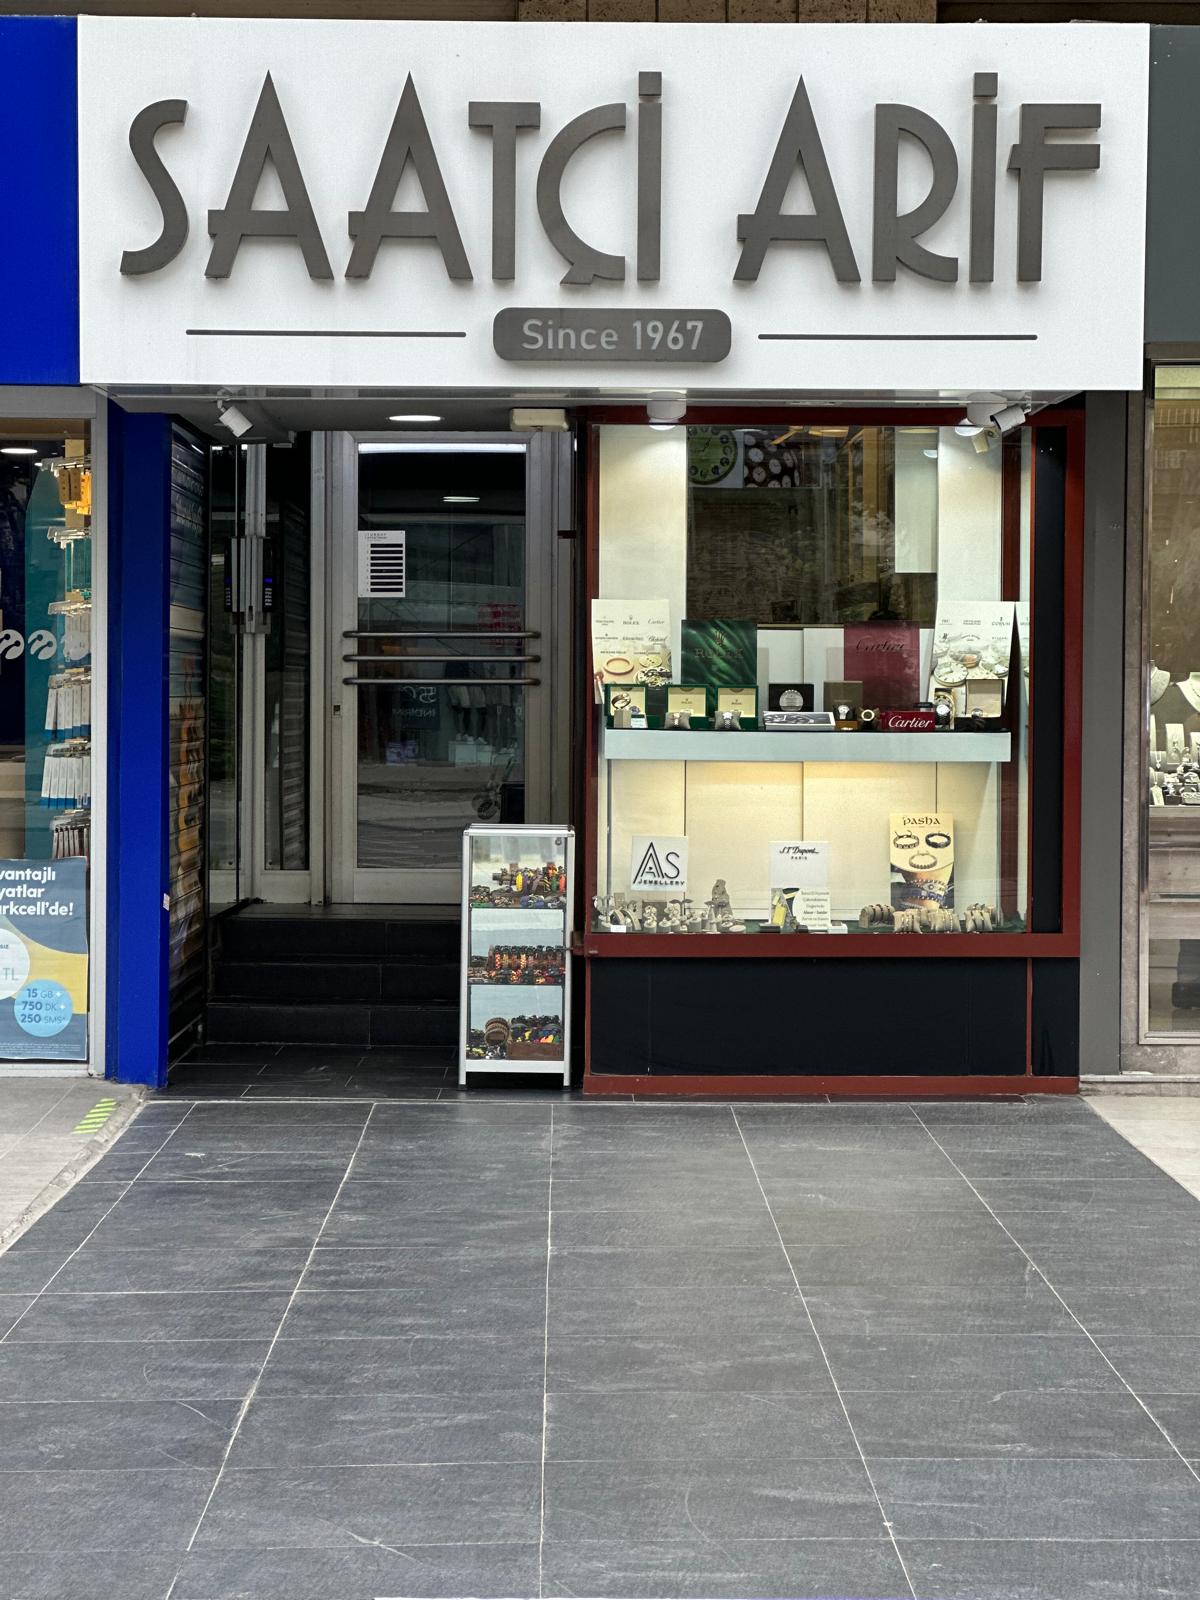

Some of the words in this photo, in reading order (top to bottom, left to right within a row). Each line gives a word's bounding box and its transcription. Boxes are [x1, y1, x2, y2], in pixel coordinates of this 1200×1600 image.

[119, 70, 662, 285] SAATÇİ
[732, 72, 1102, 283] ARİF
[521, 318, 619, 350] Since
[632, 320, 704, 350] 1967
[888, 714, 933, 729] Cartier
[3, 967, 19, 981] TL
[27, 988, 38, 998] 15
[40, 990, 53, 999] GB
[22, 1001, 43, 1011] 750
[45, 1003, 57, 1011] DK
[20, 1014, 41, 1023] 250
